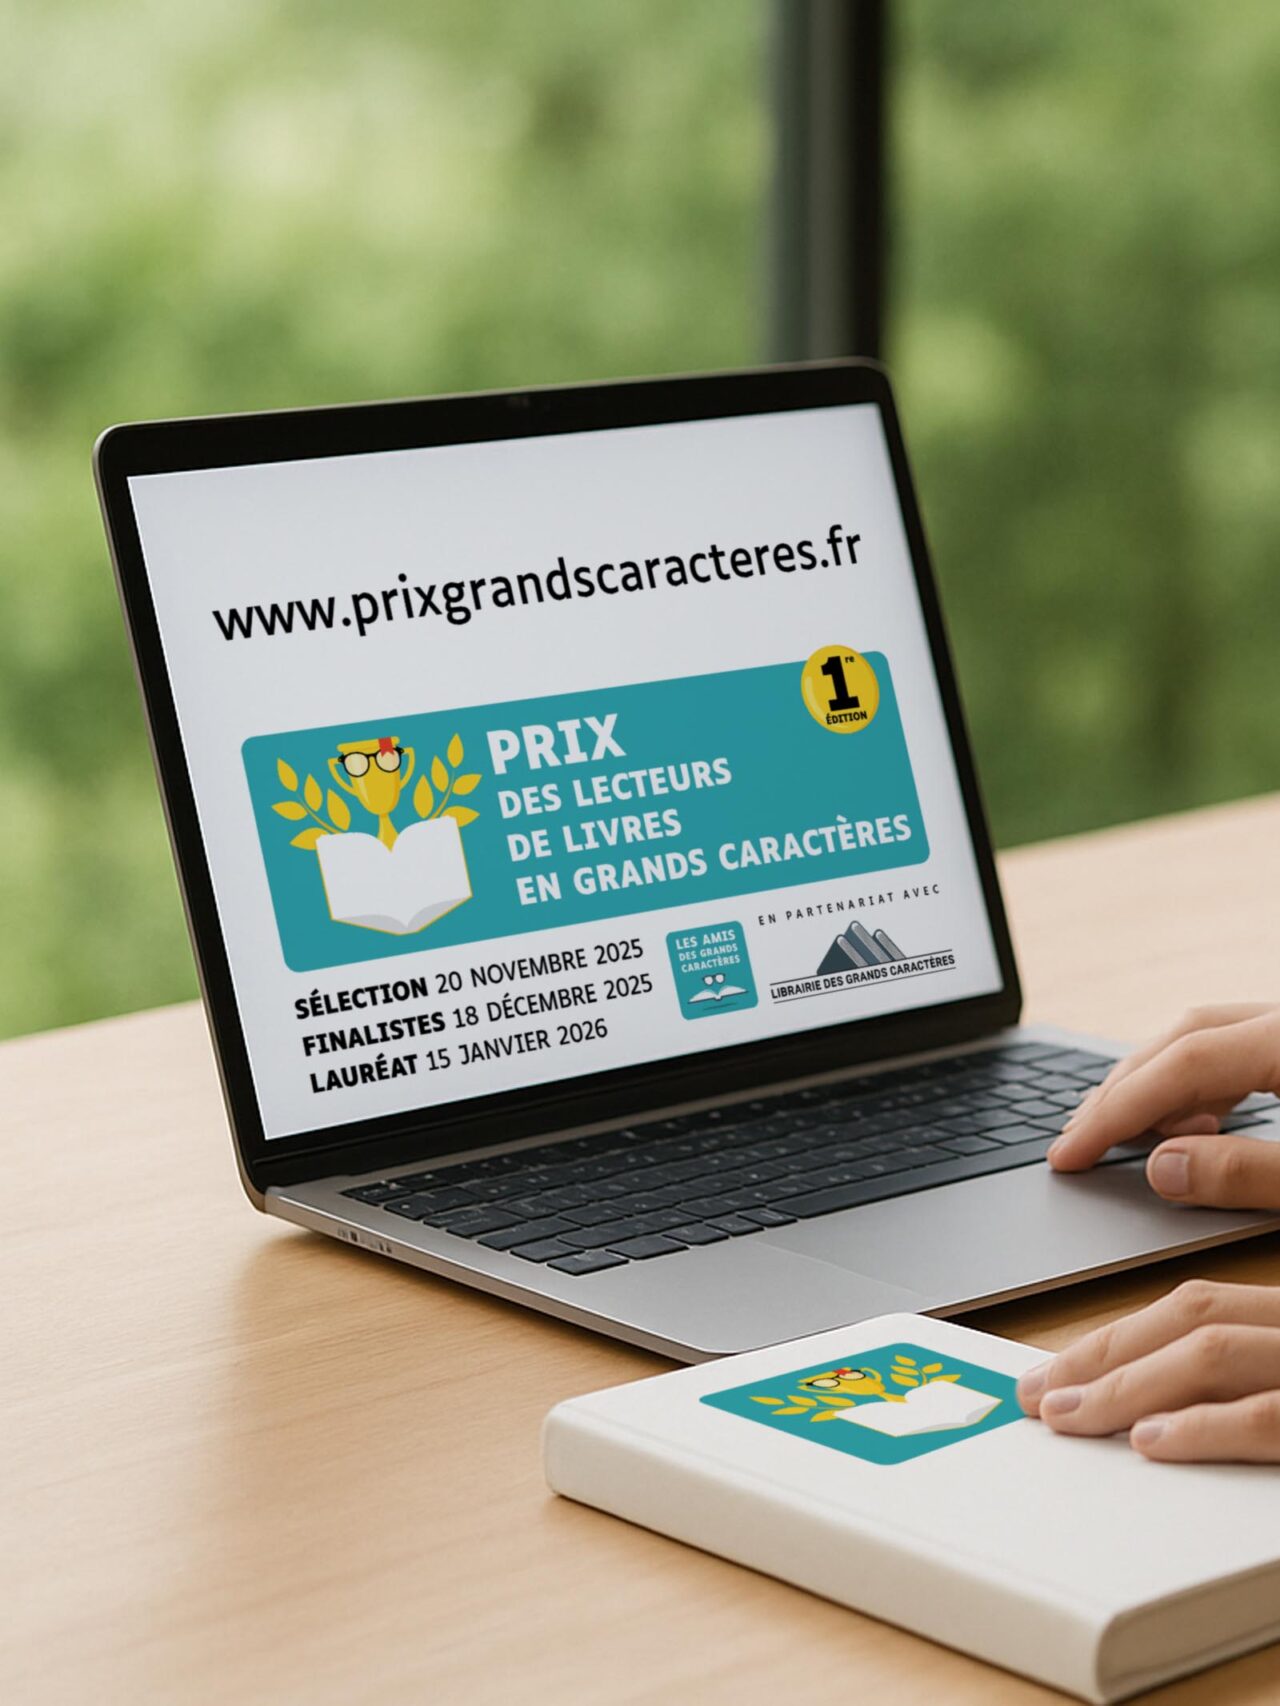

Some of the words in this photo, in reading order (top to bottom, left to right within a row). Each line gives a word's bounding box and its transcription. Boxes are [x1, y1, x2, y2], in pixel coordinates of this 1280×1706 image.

[212, 525, 860, 640] www.prixgrandscaracteres.fr
[487, 714, 625, 774] PRIX
[826, 711, 867, 725] ÉDITION
[498, 784, 561, 818] DES
[573, 758, 731, 806] LECTEURS
[507, 830, 551, 861] DE
[563, 809, 681, 852] LIVRES
[517, 873, 561, 905] EN
[574, 849, 707, 894] GRANDS
[719, 815, 911, 870] CARACTÈRES
[758, 914, 776, 926] EN
[786, 892, 894, 921] PARTENARIAT
[903, 884, 940, 900] AVEC
[675, 936, 697, 950] LES
[702, 929, 736, 945] AMIS
[679, 951, 697, 961] DES
[700, 943, 738, 958] GRANDS
[681, 954, 740, 973] CARACTÈRES
[295, 977, 428, 1019] SÉLECTION
[436, 971, 462, 993] 20
[471, 949, 587, 987] NOVEMBRE
[594, 939, 643, 964] 2025
[770, 980, 822, 999] LIBRAIRIE
[824, 975, 844, 989] DES
[846, 966, 887, 985] GRANDS
[889, 954, 955, 976] CARACTÈRES
[303, 1012, 445, 1056] FINALISTES
[453, 1006, 479, 1028] 18
[487, 984, 597, 1021] DÉCEMBRE
[604, 974, 652, 999] 2025
[310, 1053, 417, 1093] LAURÉAT
[427, 1048, 450, 1070] 15
[459, 1030, 550, 1065] JANVIER
[557, 1018, 607, 1045] 2026
